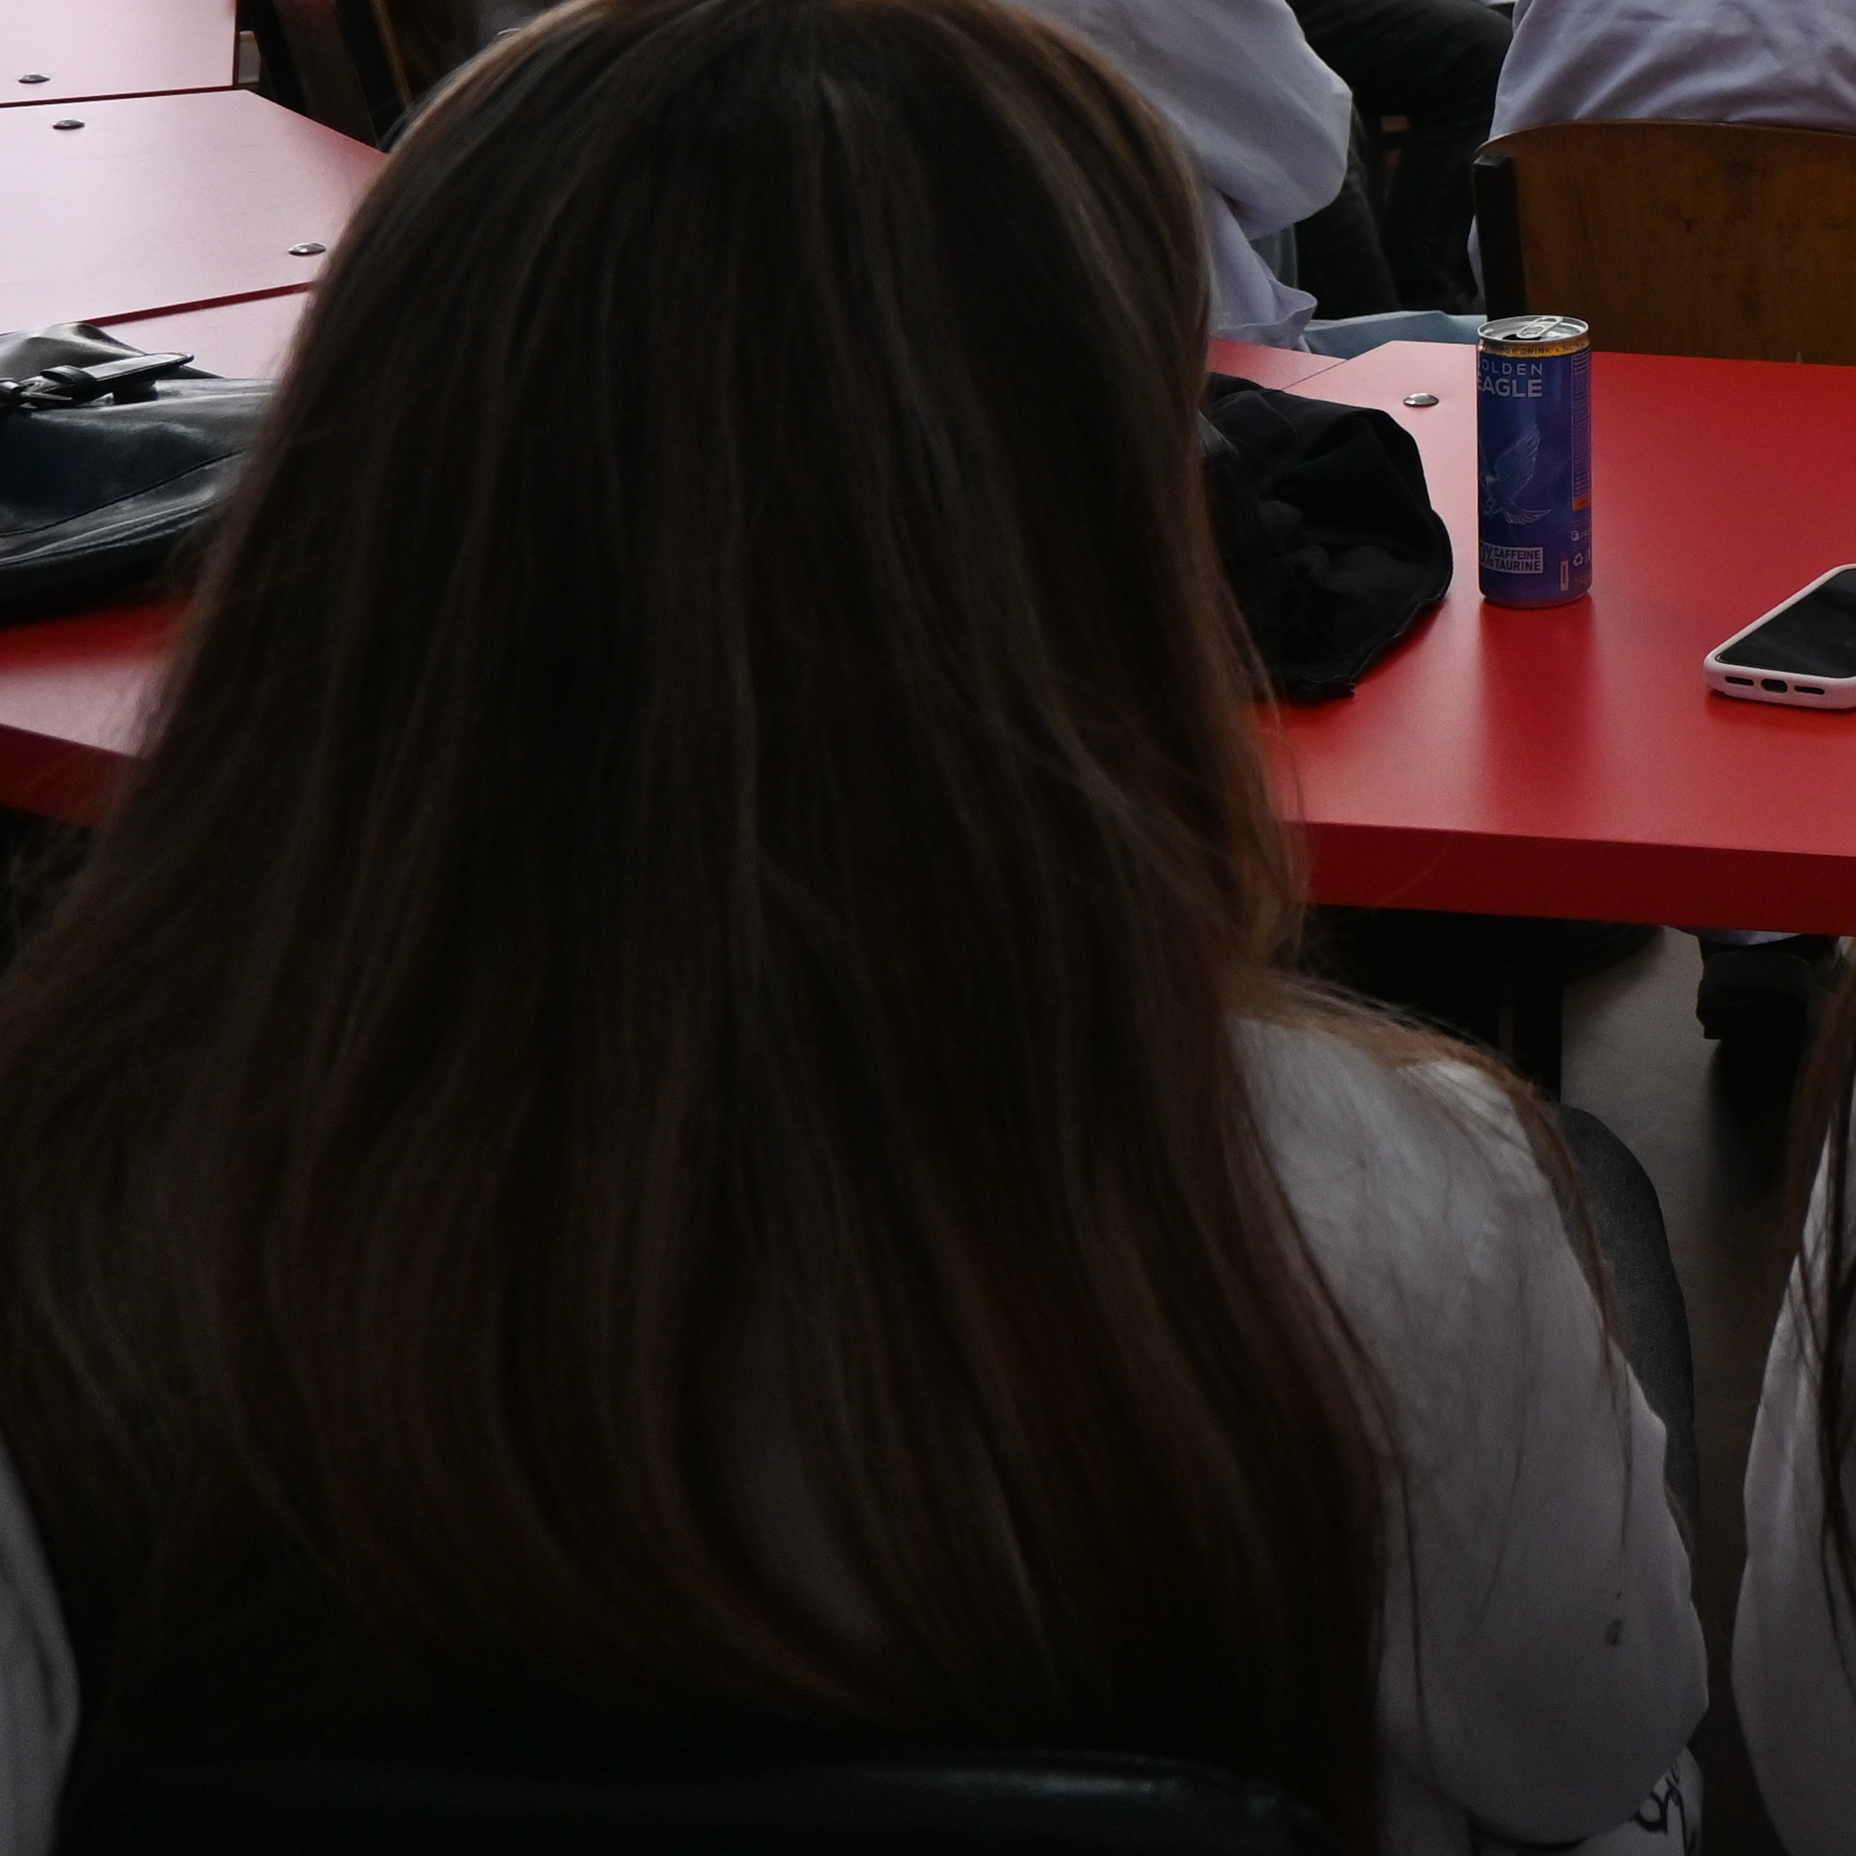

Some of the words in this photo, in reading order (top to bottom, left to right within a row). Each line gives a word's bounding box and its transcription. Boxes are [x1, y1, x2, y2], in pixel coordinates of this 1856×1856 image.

[1480, 358, 1543, 376] OLDEN
[1494, 548, 1541, 560] CAFFEINE
[1495, 559, 1541, 571] TAURINE
